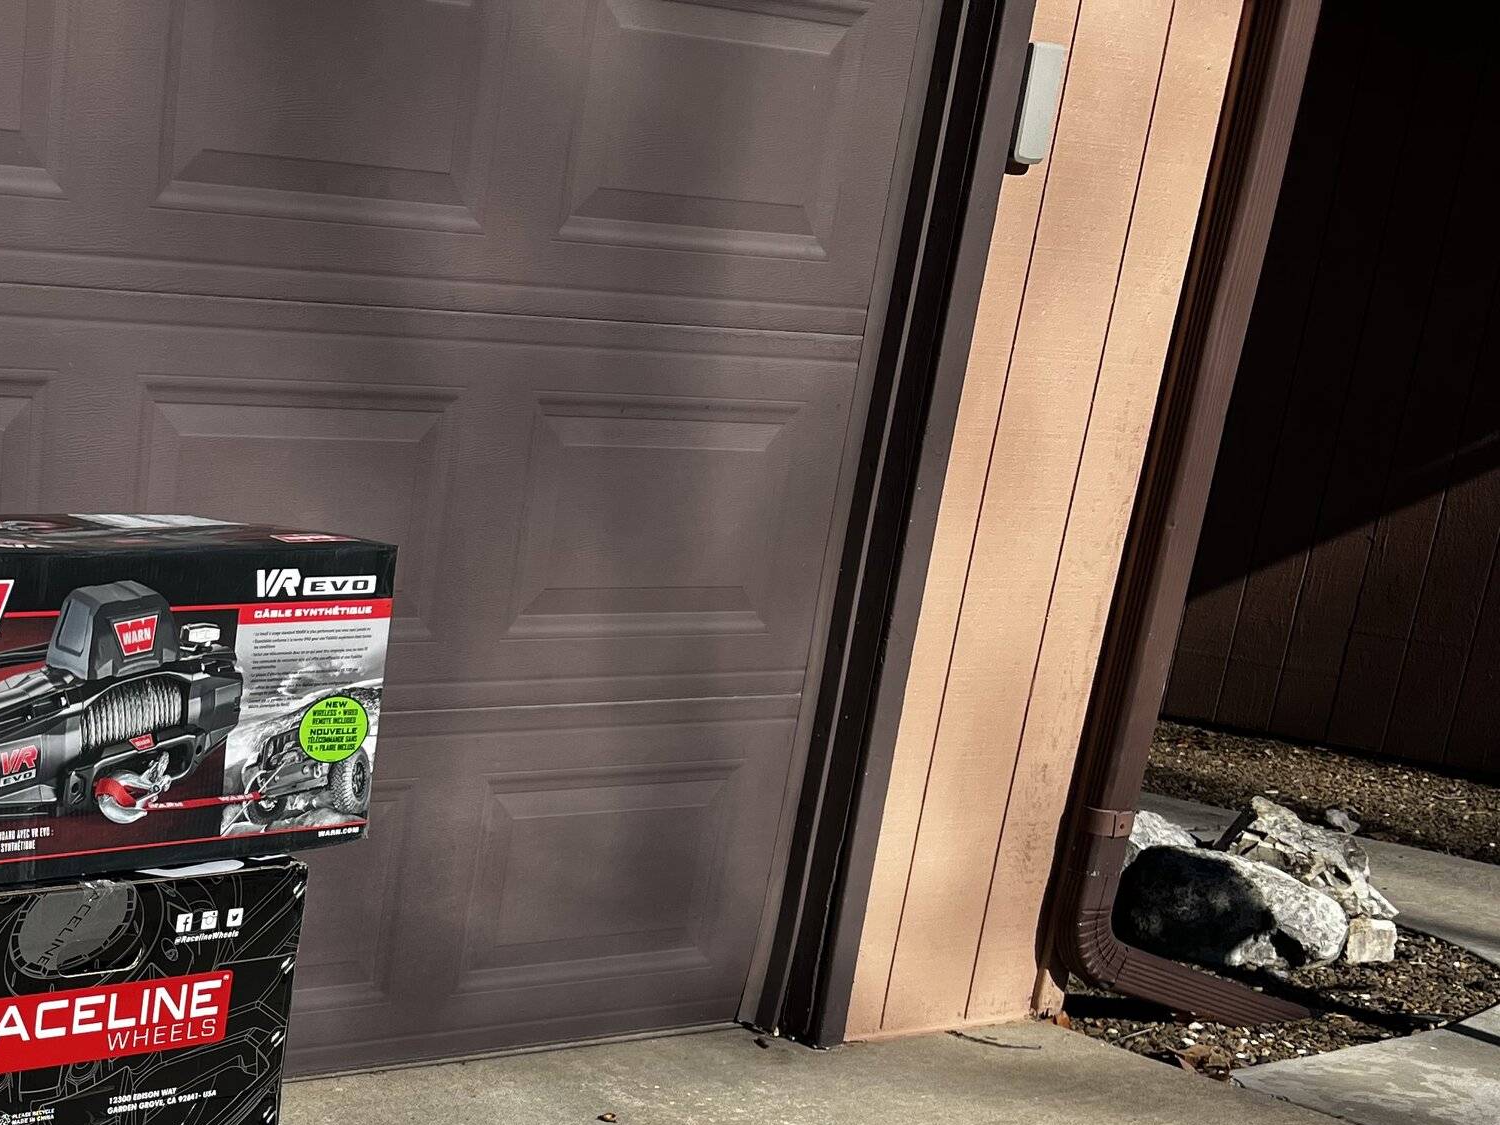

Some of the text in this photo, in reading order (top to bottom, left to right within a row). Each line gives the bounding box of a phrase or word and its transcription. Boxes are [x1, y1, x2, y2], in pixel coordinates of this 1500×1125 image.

[256, 568, 370, 598] VR EVO
[122, 628, 152, 646] WARN
[325, 701, 348, 709] NEW
[309, 727, 358, 736] NOUVELLE
[0, 745, 39, 776] VR
[3, 772, 33, 785] EVO
[107, 1017, 216, 1052] WHEELS
[161, 1087, 178, 1097] WAY
[166, 1096, 177, 1105] CA
[202, 1089, 217, 1099] USA
